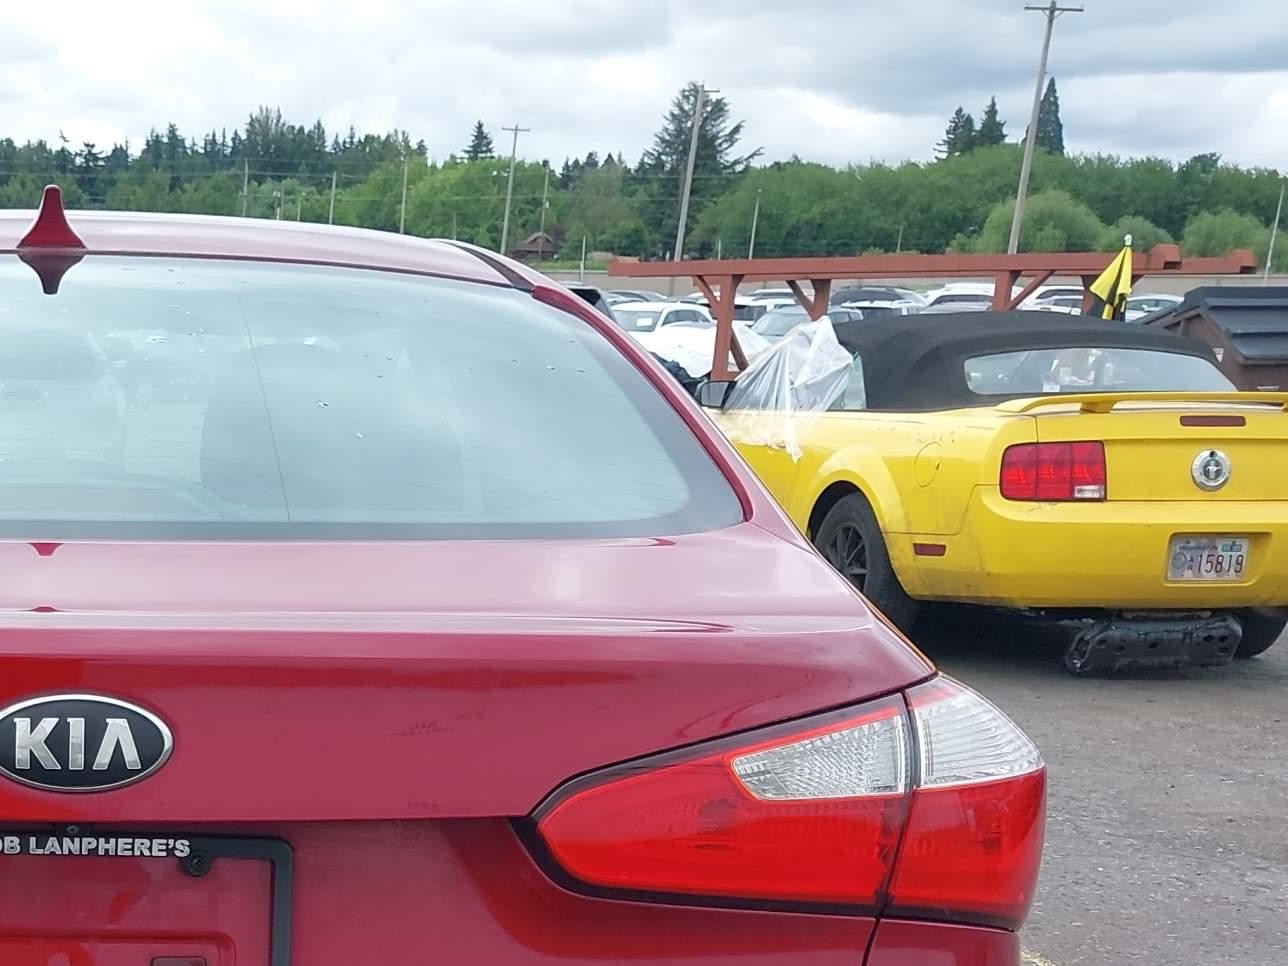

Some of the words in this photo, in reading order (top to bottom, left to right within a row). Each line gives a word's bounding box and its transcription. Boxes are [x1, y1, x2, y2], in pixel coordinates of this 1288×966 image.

[1197, 554, 1244, 574] 15819
[13, 717, 142, 770] KIA
[29, 836, 190, 857] LANPHERE'S
